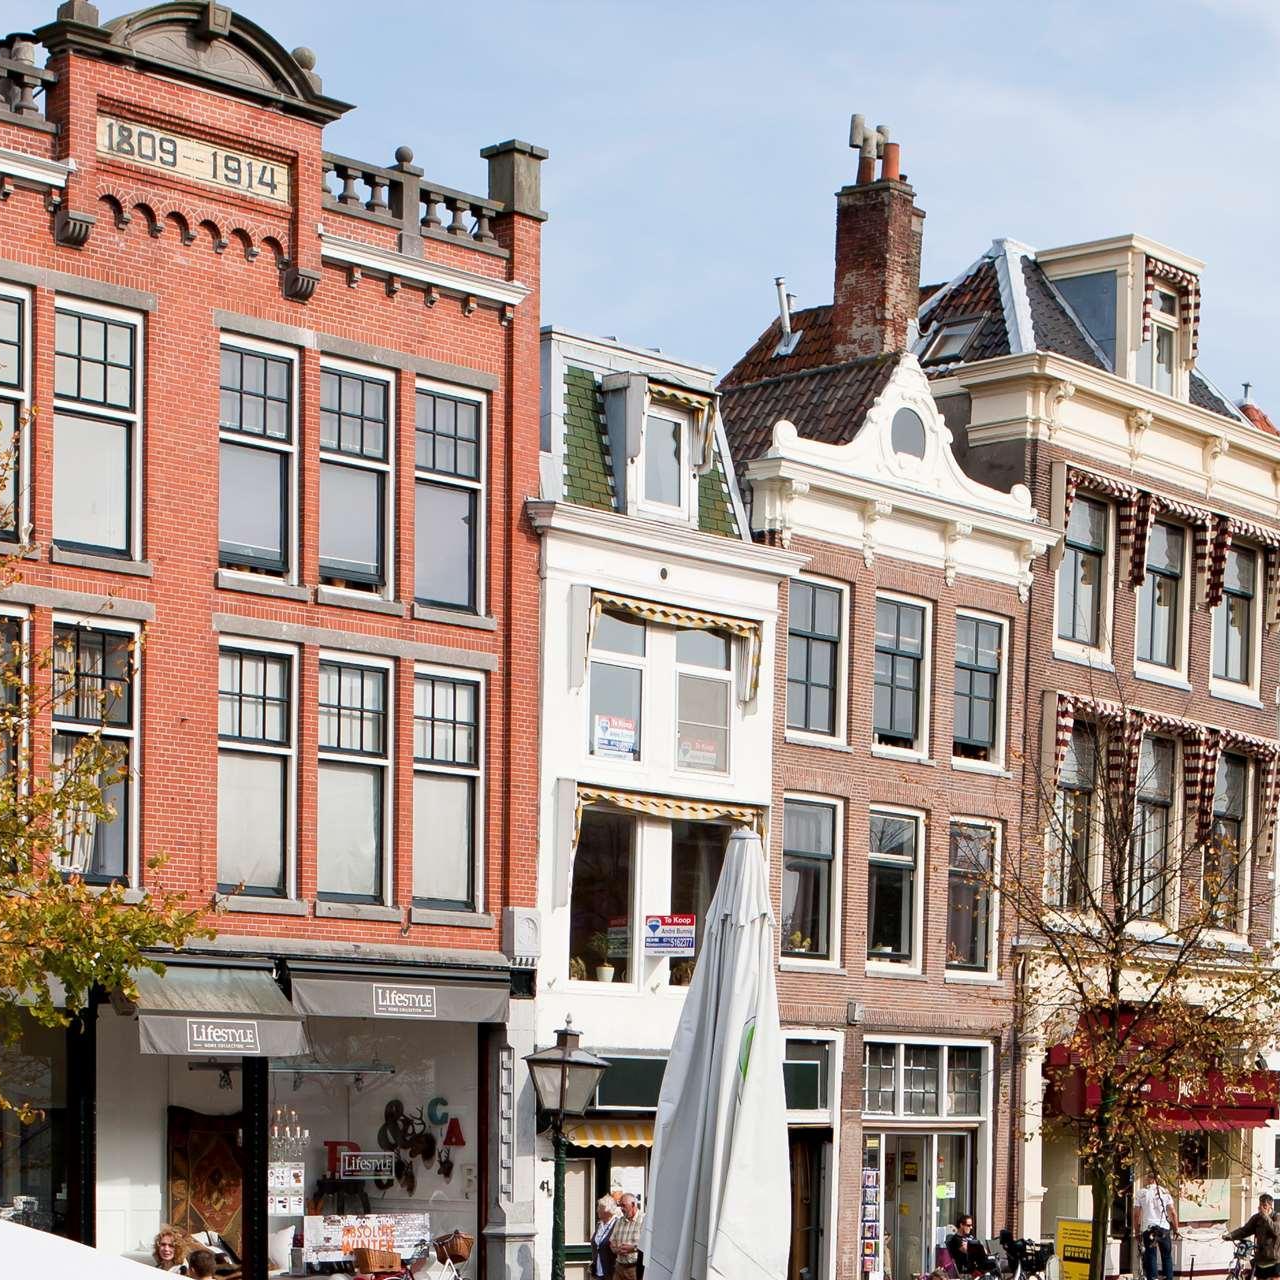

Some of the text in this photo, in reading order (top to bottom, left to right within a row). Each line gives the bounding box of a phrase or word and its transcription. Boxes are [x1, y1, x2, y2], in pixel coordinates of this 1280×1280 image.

[106, 122, 278, 195] 1809 1914
[663, 916, 692, 925] To Koop
